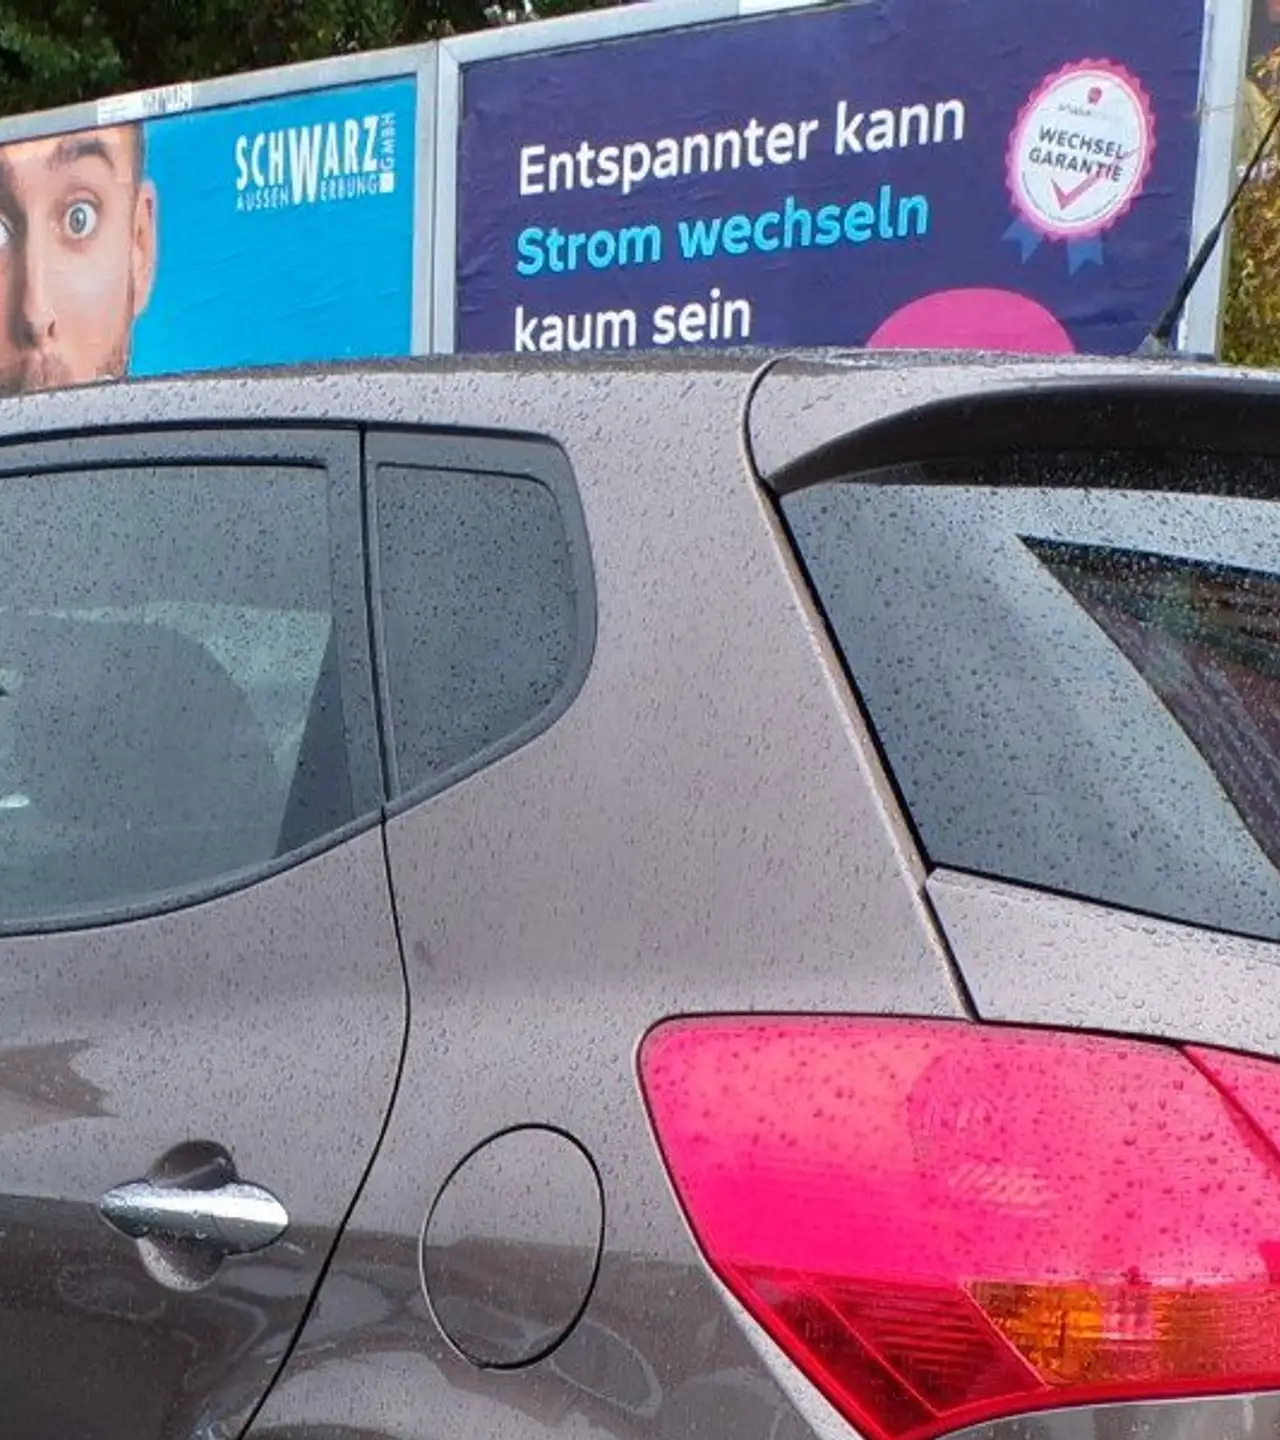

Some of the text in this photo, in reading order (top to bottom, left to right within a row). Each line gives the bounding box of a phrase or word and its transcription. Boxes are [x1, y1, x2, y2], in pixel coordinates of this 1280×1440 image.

[234, 115, 380, 206] SCHWARZ
[519, 98, 966, 196] Entspannter kann
[1027, 146, 1124, 182] GARANTIE
[516, 184, 930, 276] Strom wechseln
[514, 288, 751, 352] kaum sein
